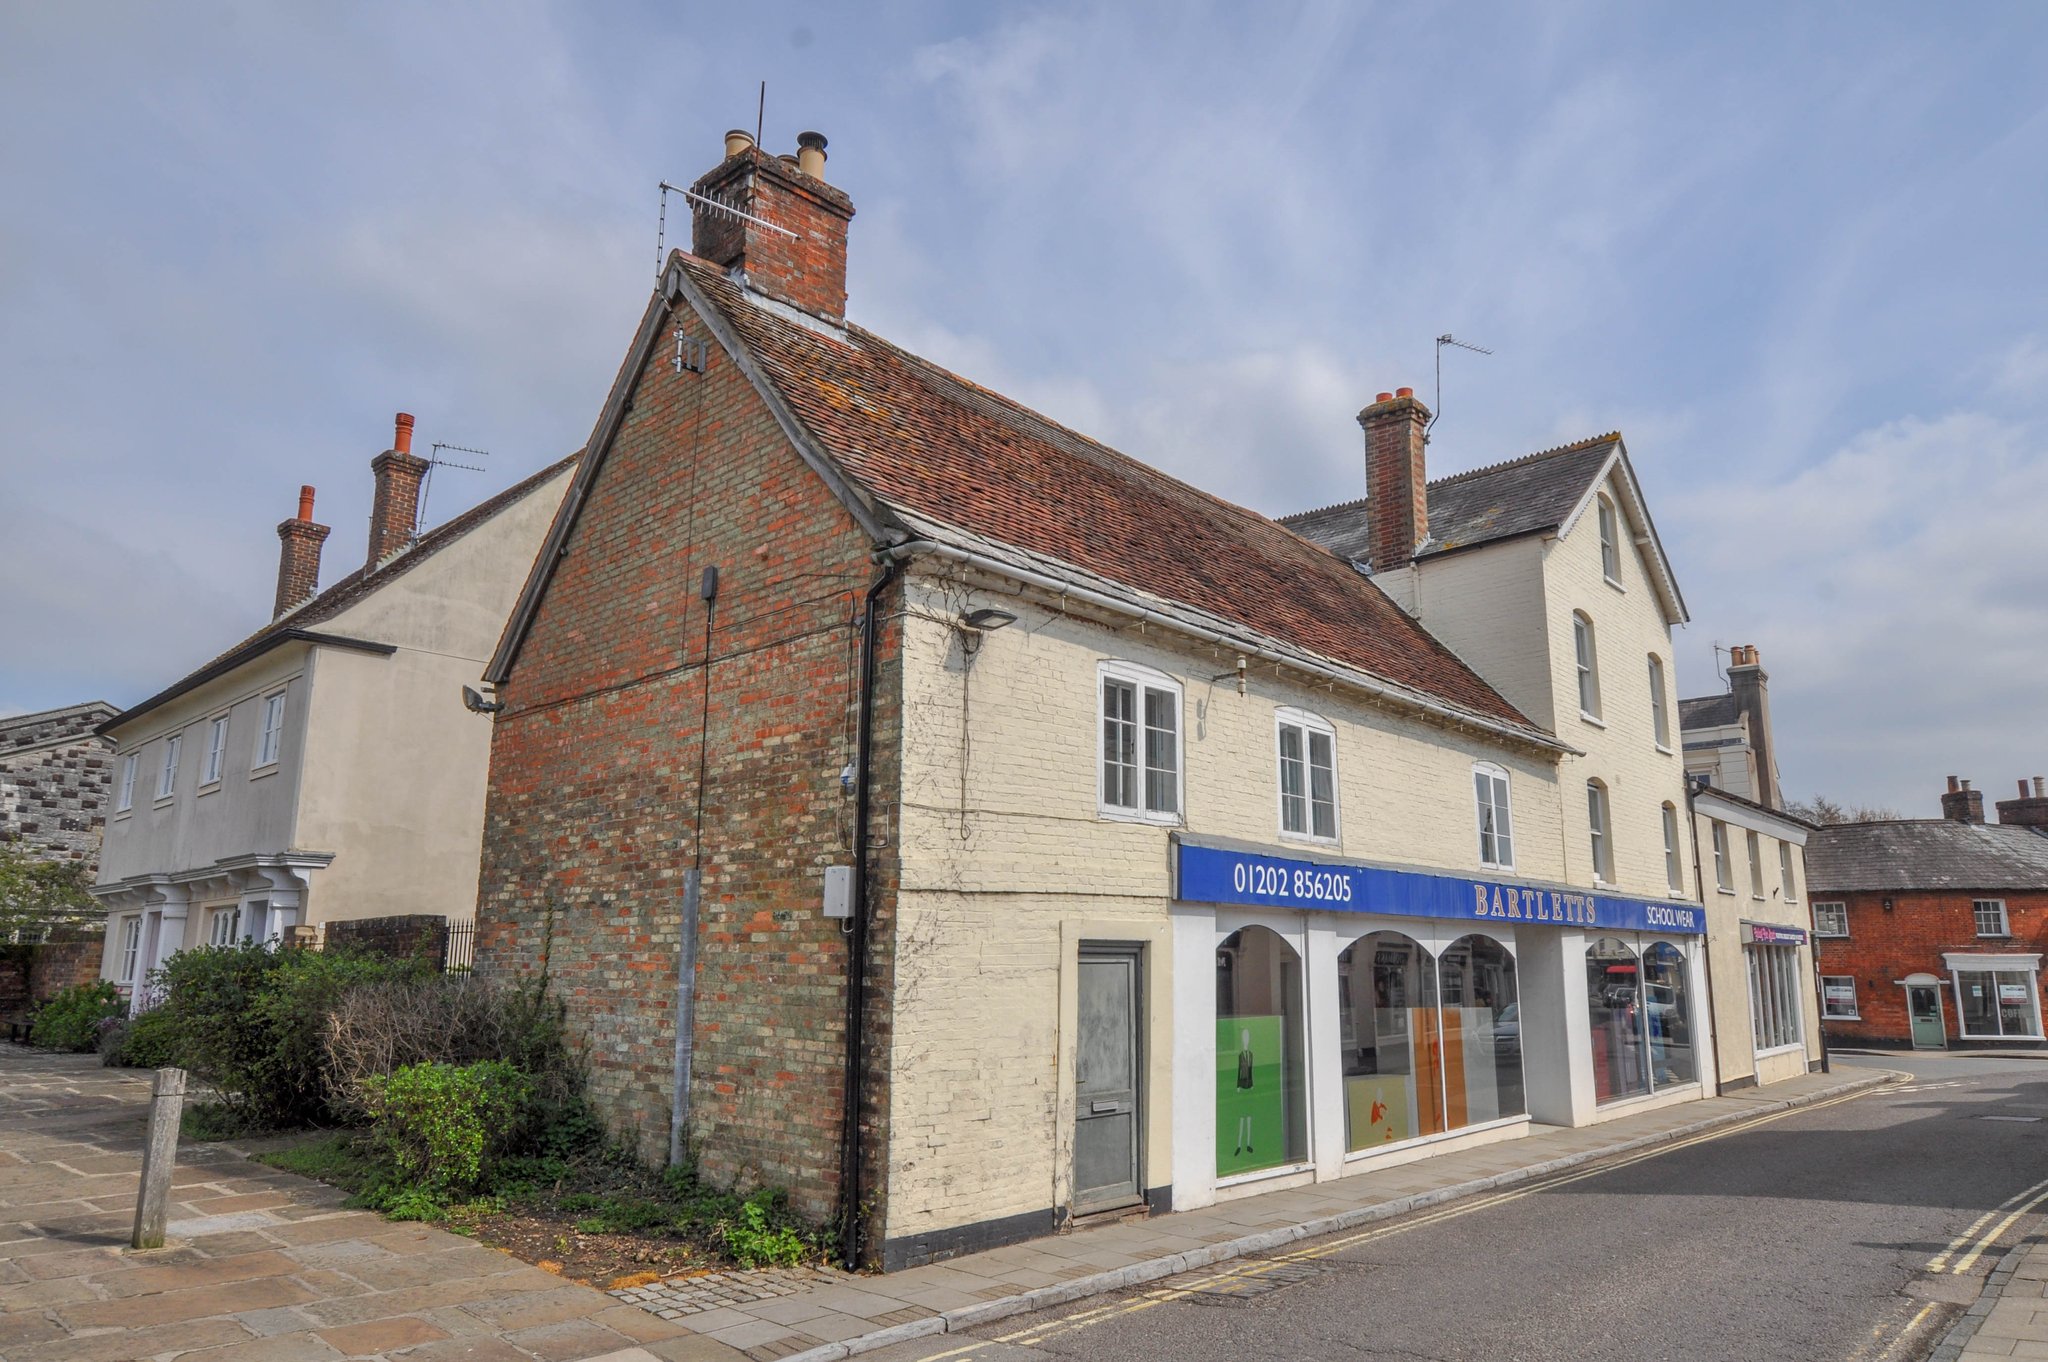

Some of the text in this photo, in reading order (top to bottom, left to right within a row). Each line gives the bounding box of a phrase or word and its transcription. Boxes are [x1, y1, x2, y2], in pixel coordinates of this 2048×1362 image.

[1234, 863, 1351, 902] 01202 856205
[1474, 884, 1596, 924] BARTLETTS
[1647, 906, 1695, 928] SCHOOL WEAR
